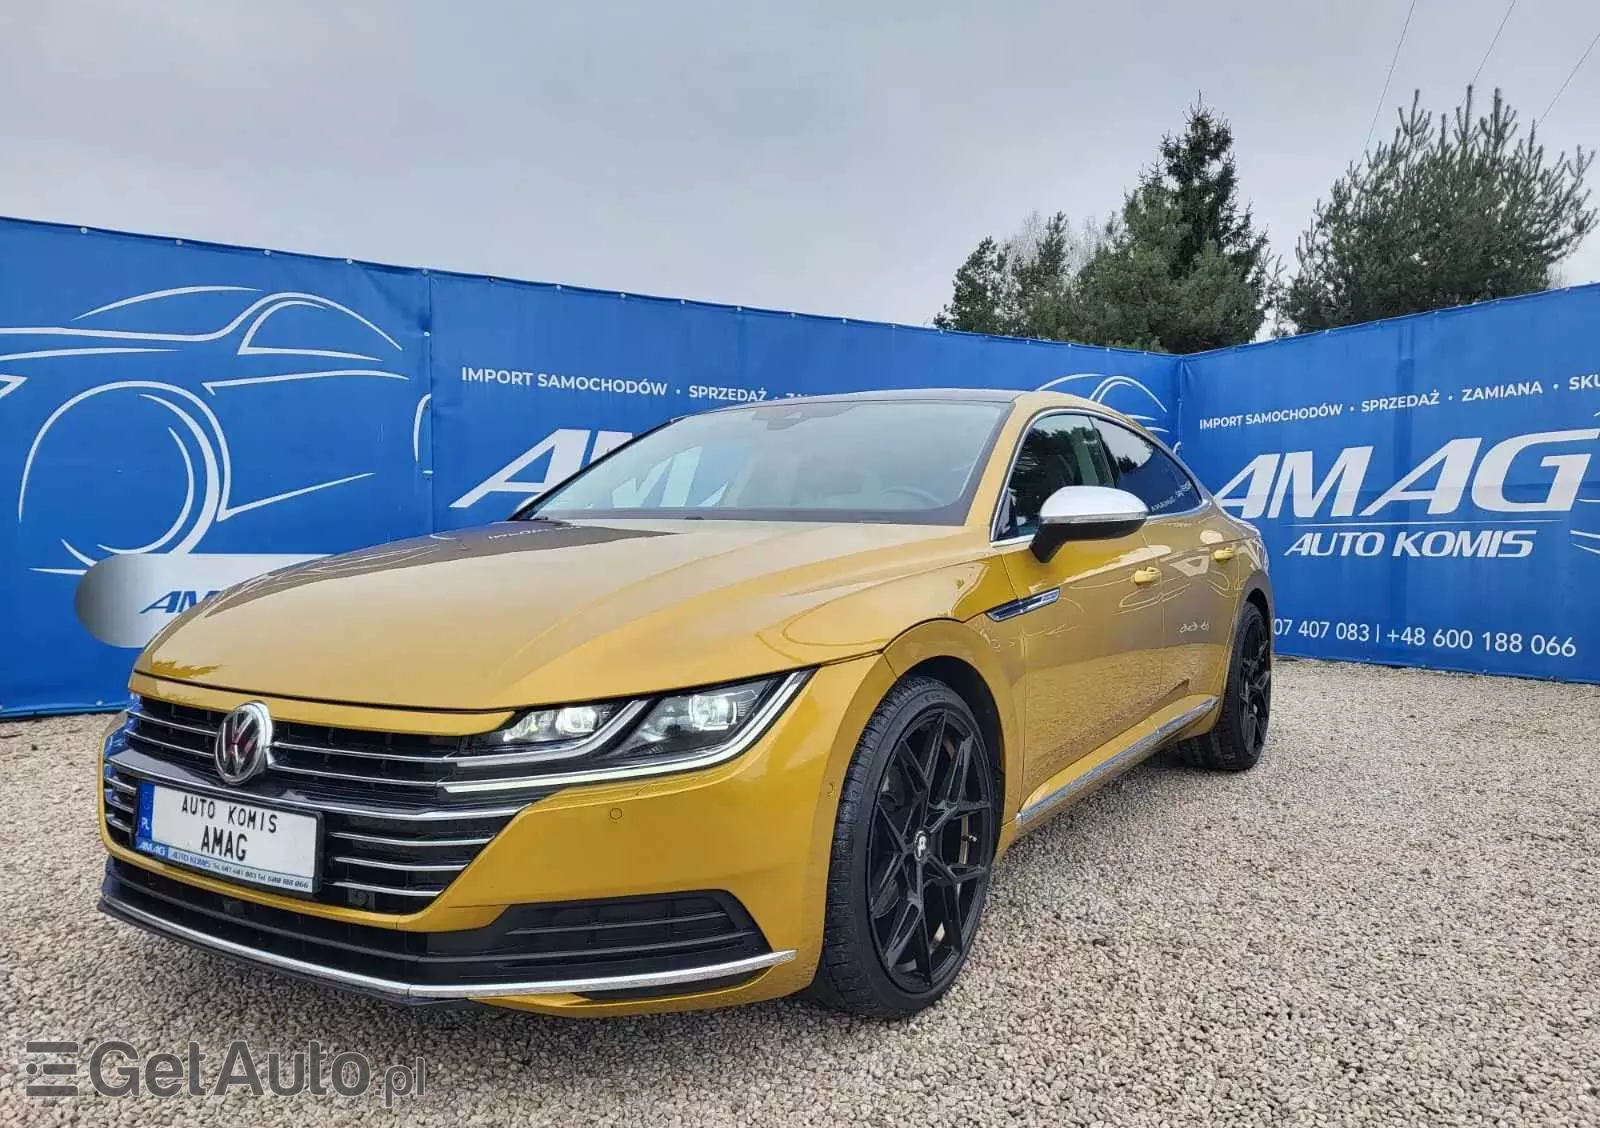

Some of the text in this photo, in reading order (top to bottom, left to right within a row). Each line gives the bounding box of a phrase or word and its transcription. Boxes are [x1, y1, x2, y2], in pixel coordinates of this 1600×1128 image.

[462, 366, 768, 402] IMPORT SAMOCHODÓW SPRZEDAŻ
[1199, 415, 1243, 430] IMPORT
[1245, 403, 1343, 425] SAMOCHODÓW
[1361, 389, 1440, 413] SPRZEDAŻ
[1461, 381, 1543, 402] ZAMIANA
[1284, 530, 1537, 558] AUTO KOMIS
[1298, 620, 1330, 639] 407
[1336, 622, 1370, 642] 083
[1386, 626, 1426, 646] +48
[1432, 628, 1473, 649] 600
[1482, 631, 1522, 653] 188
[1530, 635, 1577, 657] 066
[181, 795, 278, 834] AUTO KOMIS
[200, 825, 248, 861] AMAG
